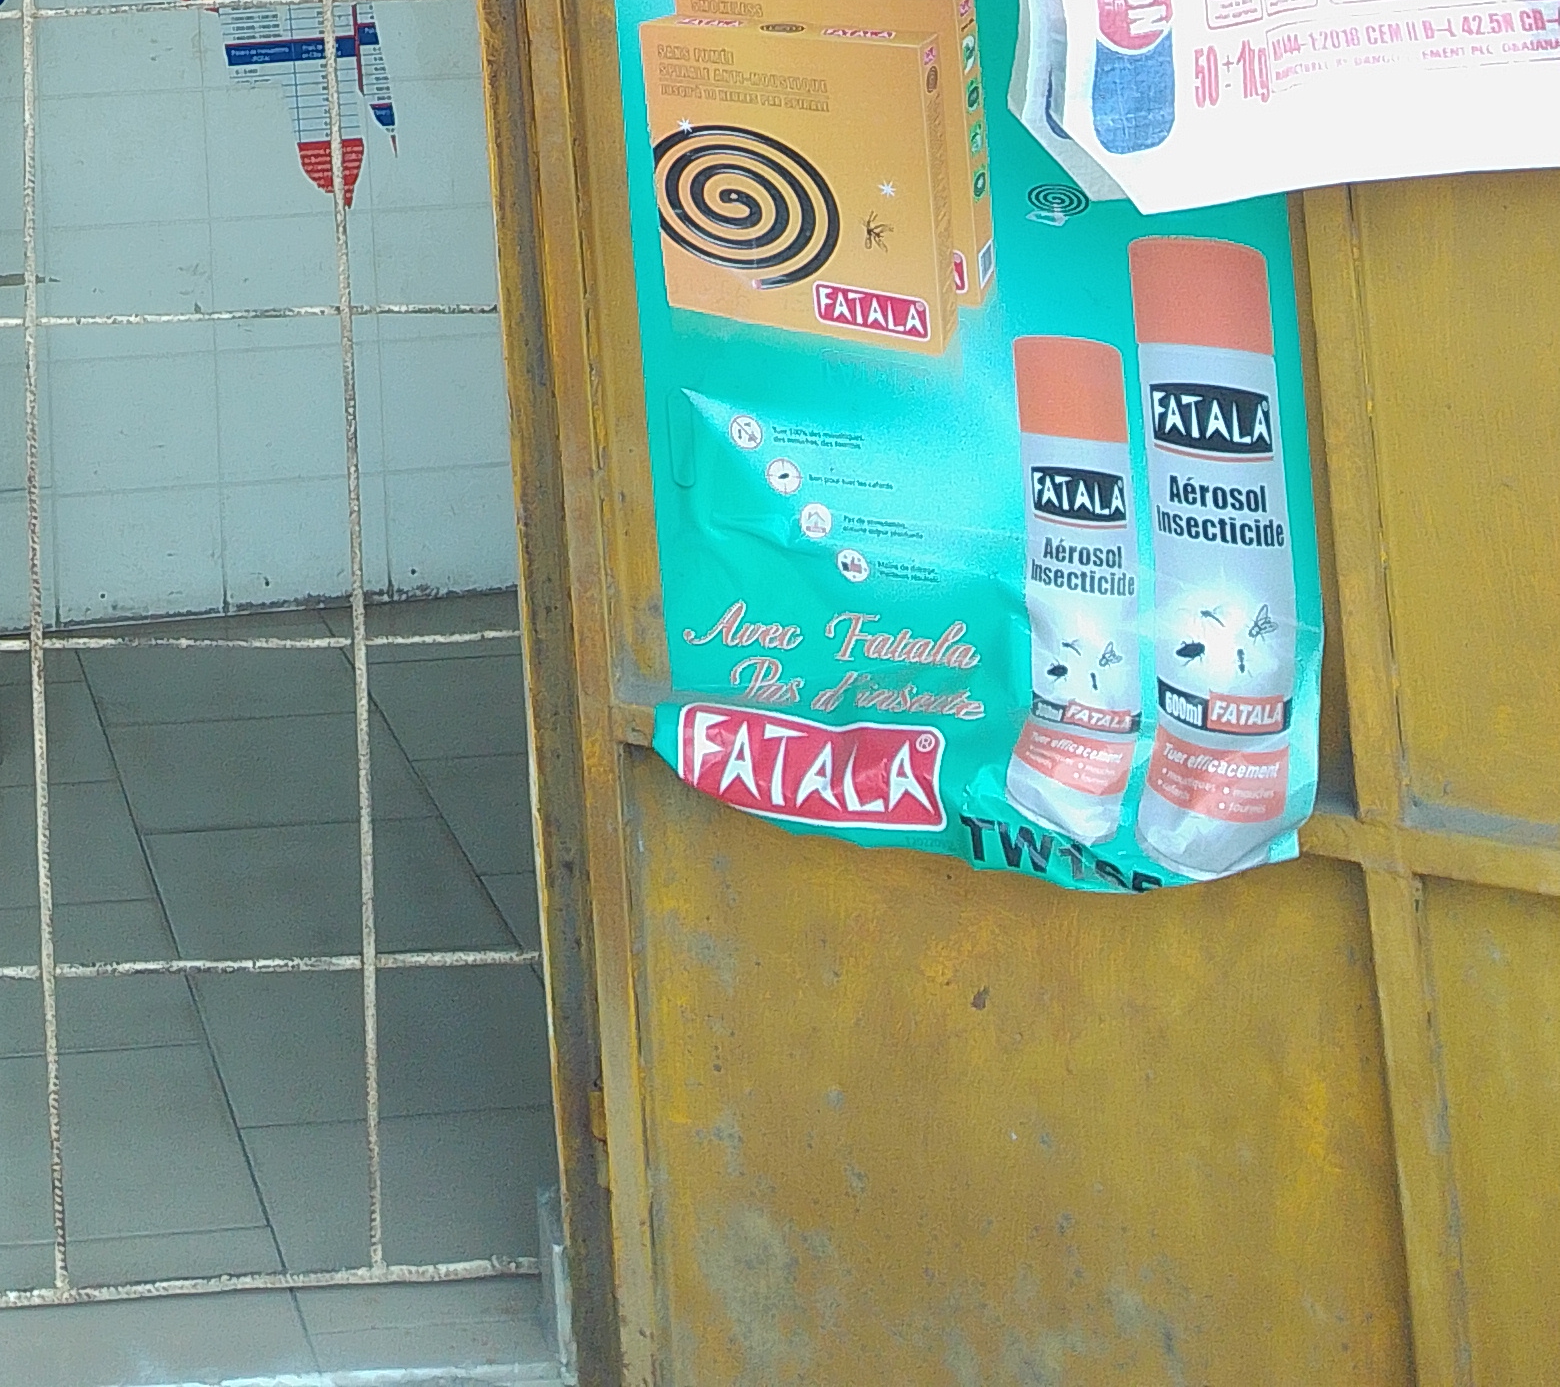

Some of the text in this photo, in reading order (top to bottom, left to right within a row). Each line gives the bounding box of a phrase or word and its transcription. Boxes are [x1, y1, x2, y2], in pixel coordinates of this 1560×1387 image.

[819, 287, 924, 335] FATALA
[1152, 391, 1271, 445] FATALA
[1033, 471, 1124, 515] FATALA
[1169, 475, 1268, 513] Aérosol
[1156, 505, 1285, 547] Insecticide
[1043, 537, 1122, 569] Aérosol
[1031, 559, 1135, 596] Insecticide
[683, 599, 981, 669] Avec Fatala
[730, 657, 804, 705] Pas
[1066, 705, 1133, 728] FATALA
[1166, 691, 1283, 726] 600ml FATALA
[692, 711, 934, 815] FATALA
[1164, 743, 1280, 778] Tuer efficacement
